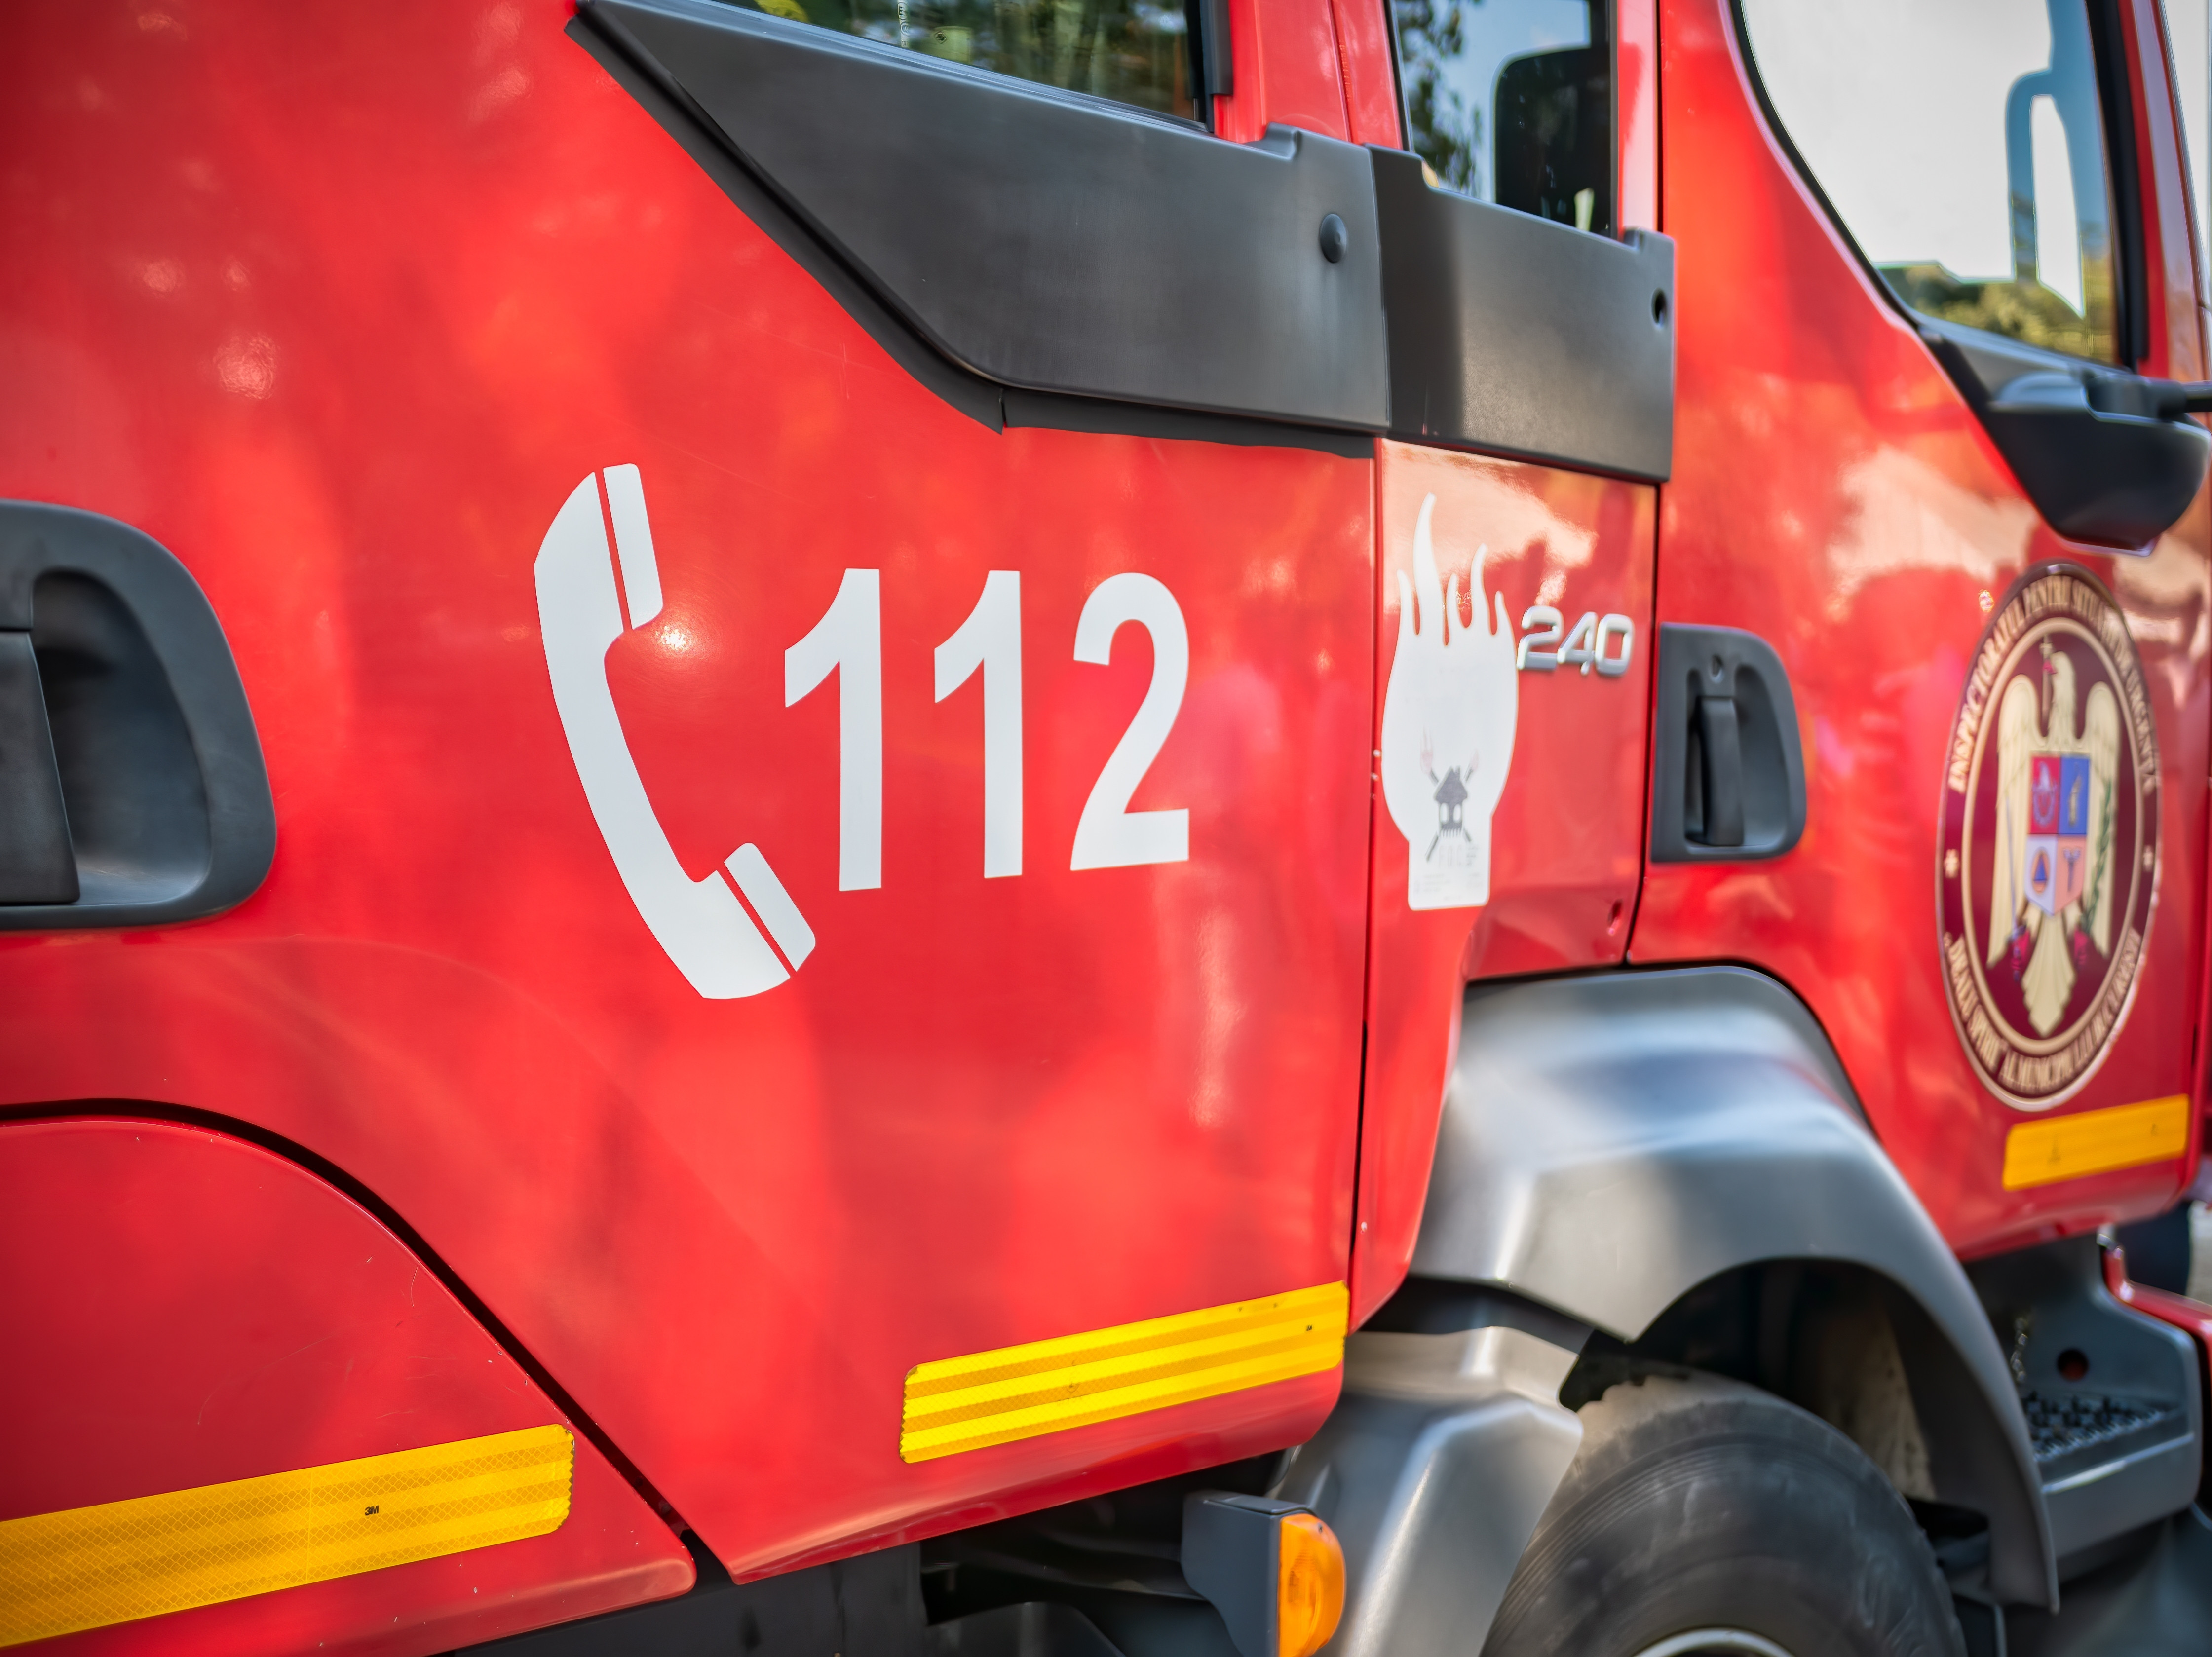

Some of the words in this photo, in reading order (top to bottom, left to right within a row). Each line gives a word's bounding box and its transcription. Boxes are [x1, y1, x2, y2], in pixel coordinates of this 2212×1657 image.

[1516, 605, 1635, 676] 240
[785, 568, 1189, 891] 112
[365, 1505, 379, 1516] 3M
